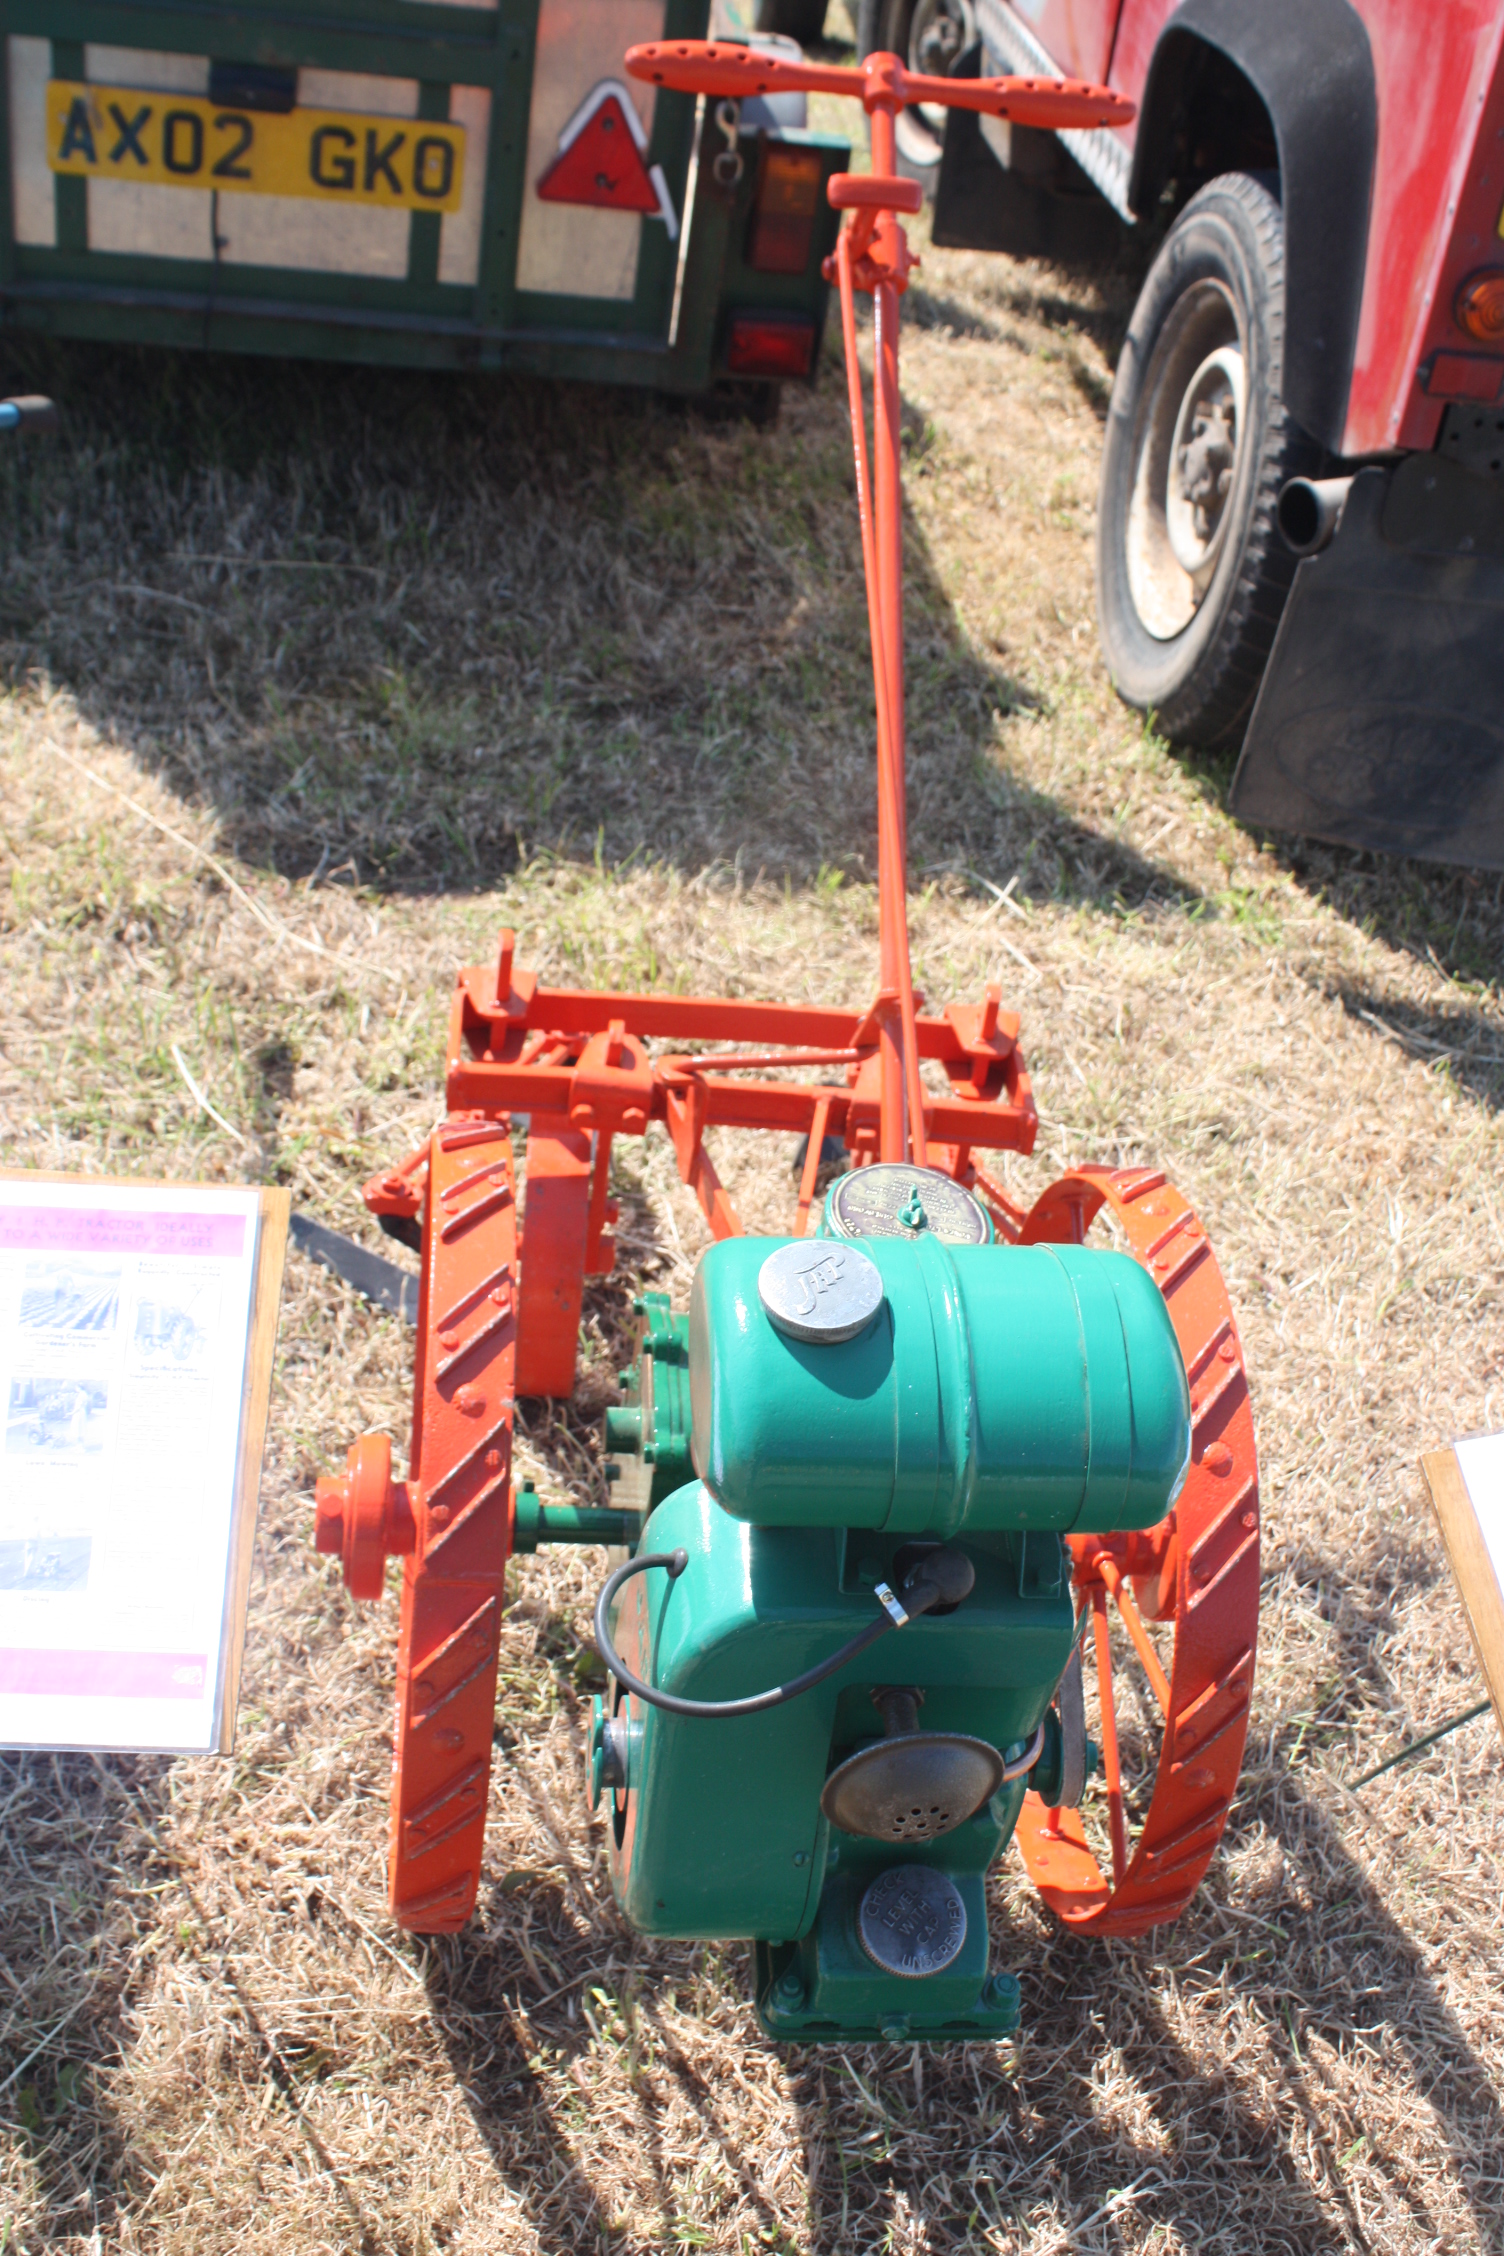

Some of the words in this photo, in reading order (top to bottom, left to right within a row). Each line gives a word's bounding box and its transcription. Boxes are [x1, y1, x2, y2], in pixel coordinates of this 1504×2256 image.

[58, 96, 254, 180] AX02
[309, 125, 456, 199] GKO
[4, 1228, 25, 1240] TO
[30, 1230, 42, 1241] A
[48, 1231, 83, 1242] WIDE
[88, 1231, 151, 1244] VARIETY
[156, 1234, 177, 1245] OF
[181, 1235, 214, 1247] USES
[78, 1217, 144, 1230] TRACTOR
[155, 1221, 215, 1233] IDEALLY
[865, 1871, 905, 1917] CHECK
[882, 1889, 919, 1928] LEVEL
[898, 1899, 931, 1936] WITH
[901, 1898, 962, 1970] UNSCREWED
[916, 1916, 940, 1945] CAP
